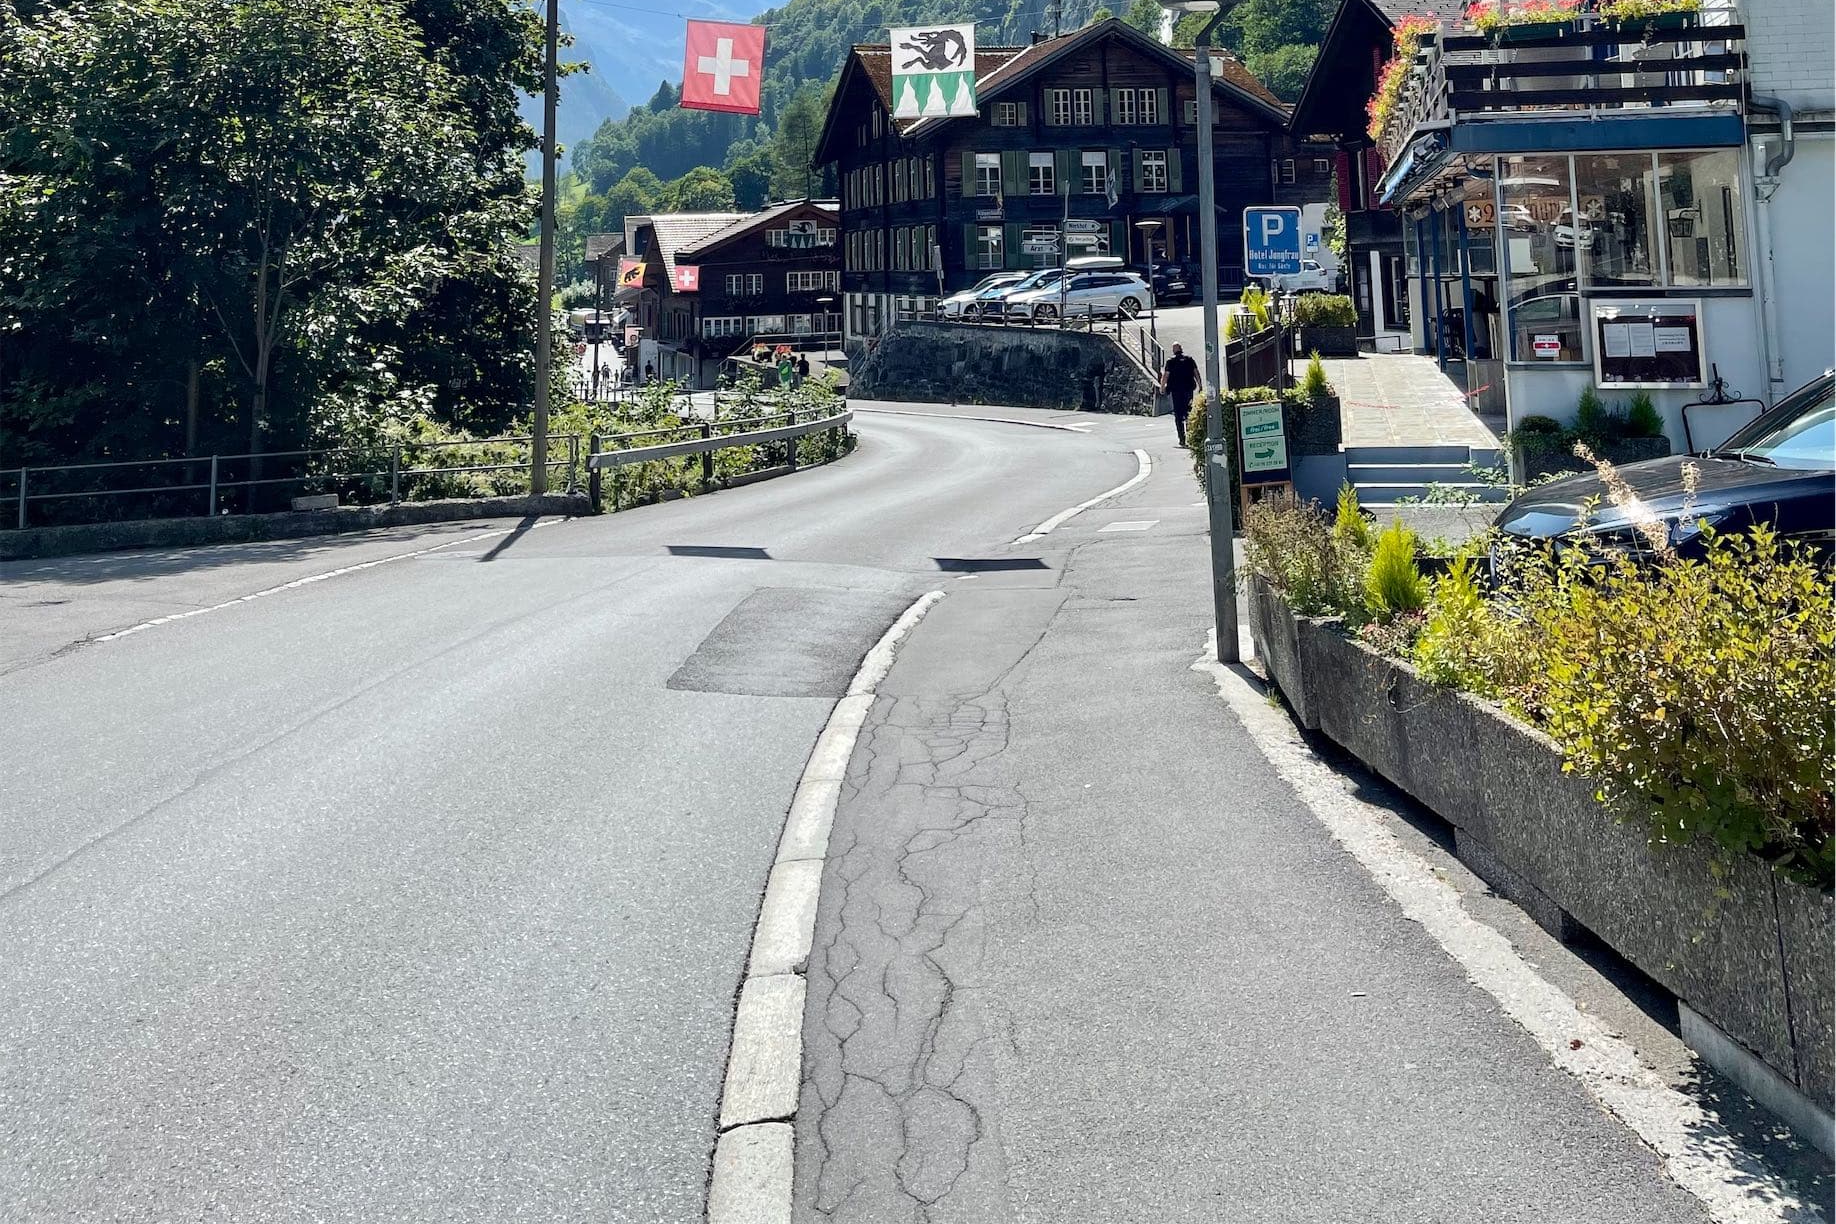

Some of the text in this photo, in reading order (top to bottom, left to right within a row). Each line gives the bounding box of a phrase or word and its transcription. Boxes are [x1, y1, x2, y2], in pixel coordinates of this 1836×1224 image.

[1262, 214, 1284, 246] P
[1307, 234, 1314, 244] P
[1249, 249, 1268, 260] Hotel
[1268, 249, 1299, 262] Jungfrau
[1249, 440, 1279, 448] RECEPTION
